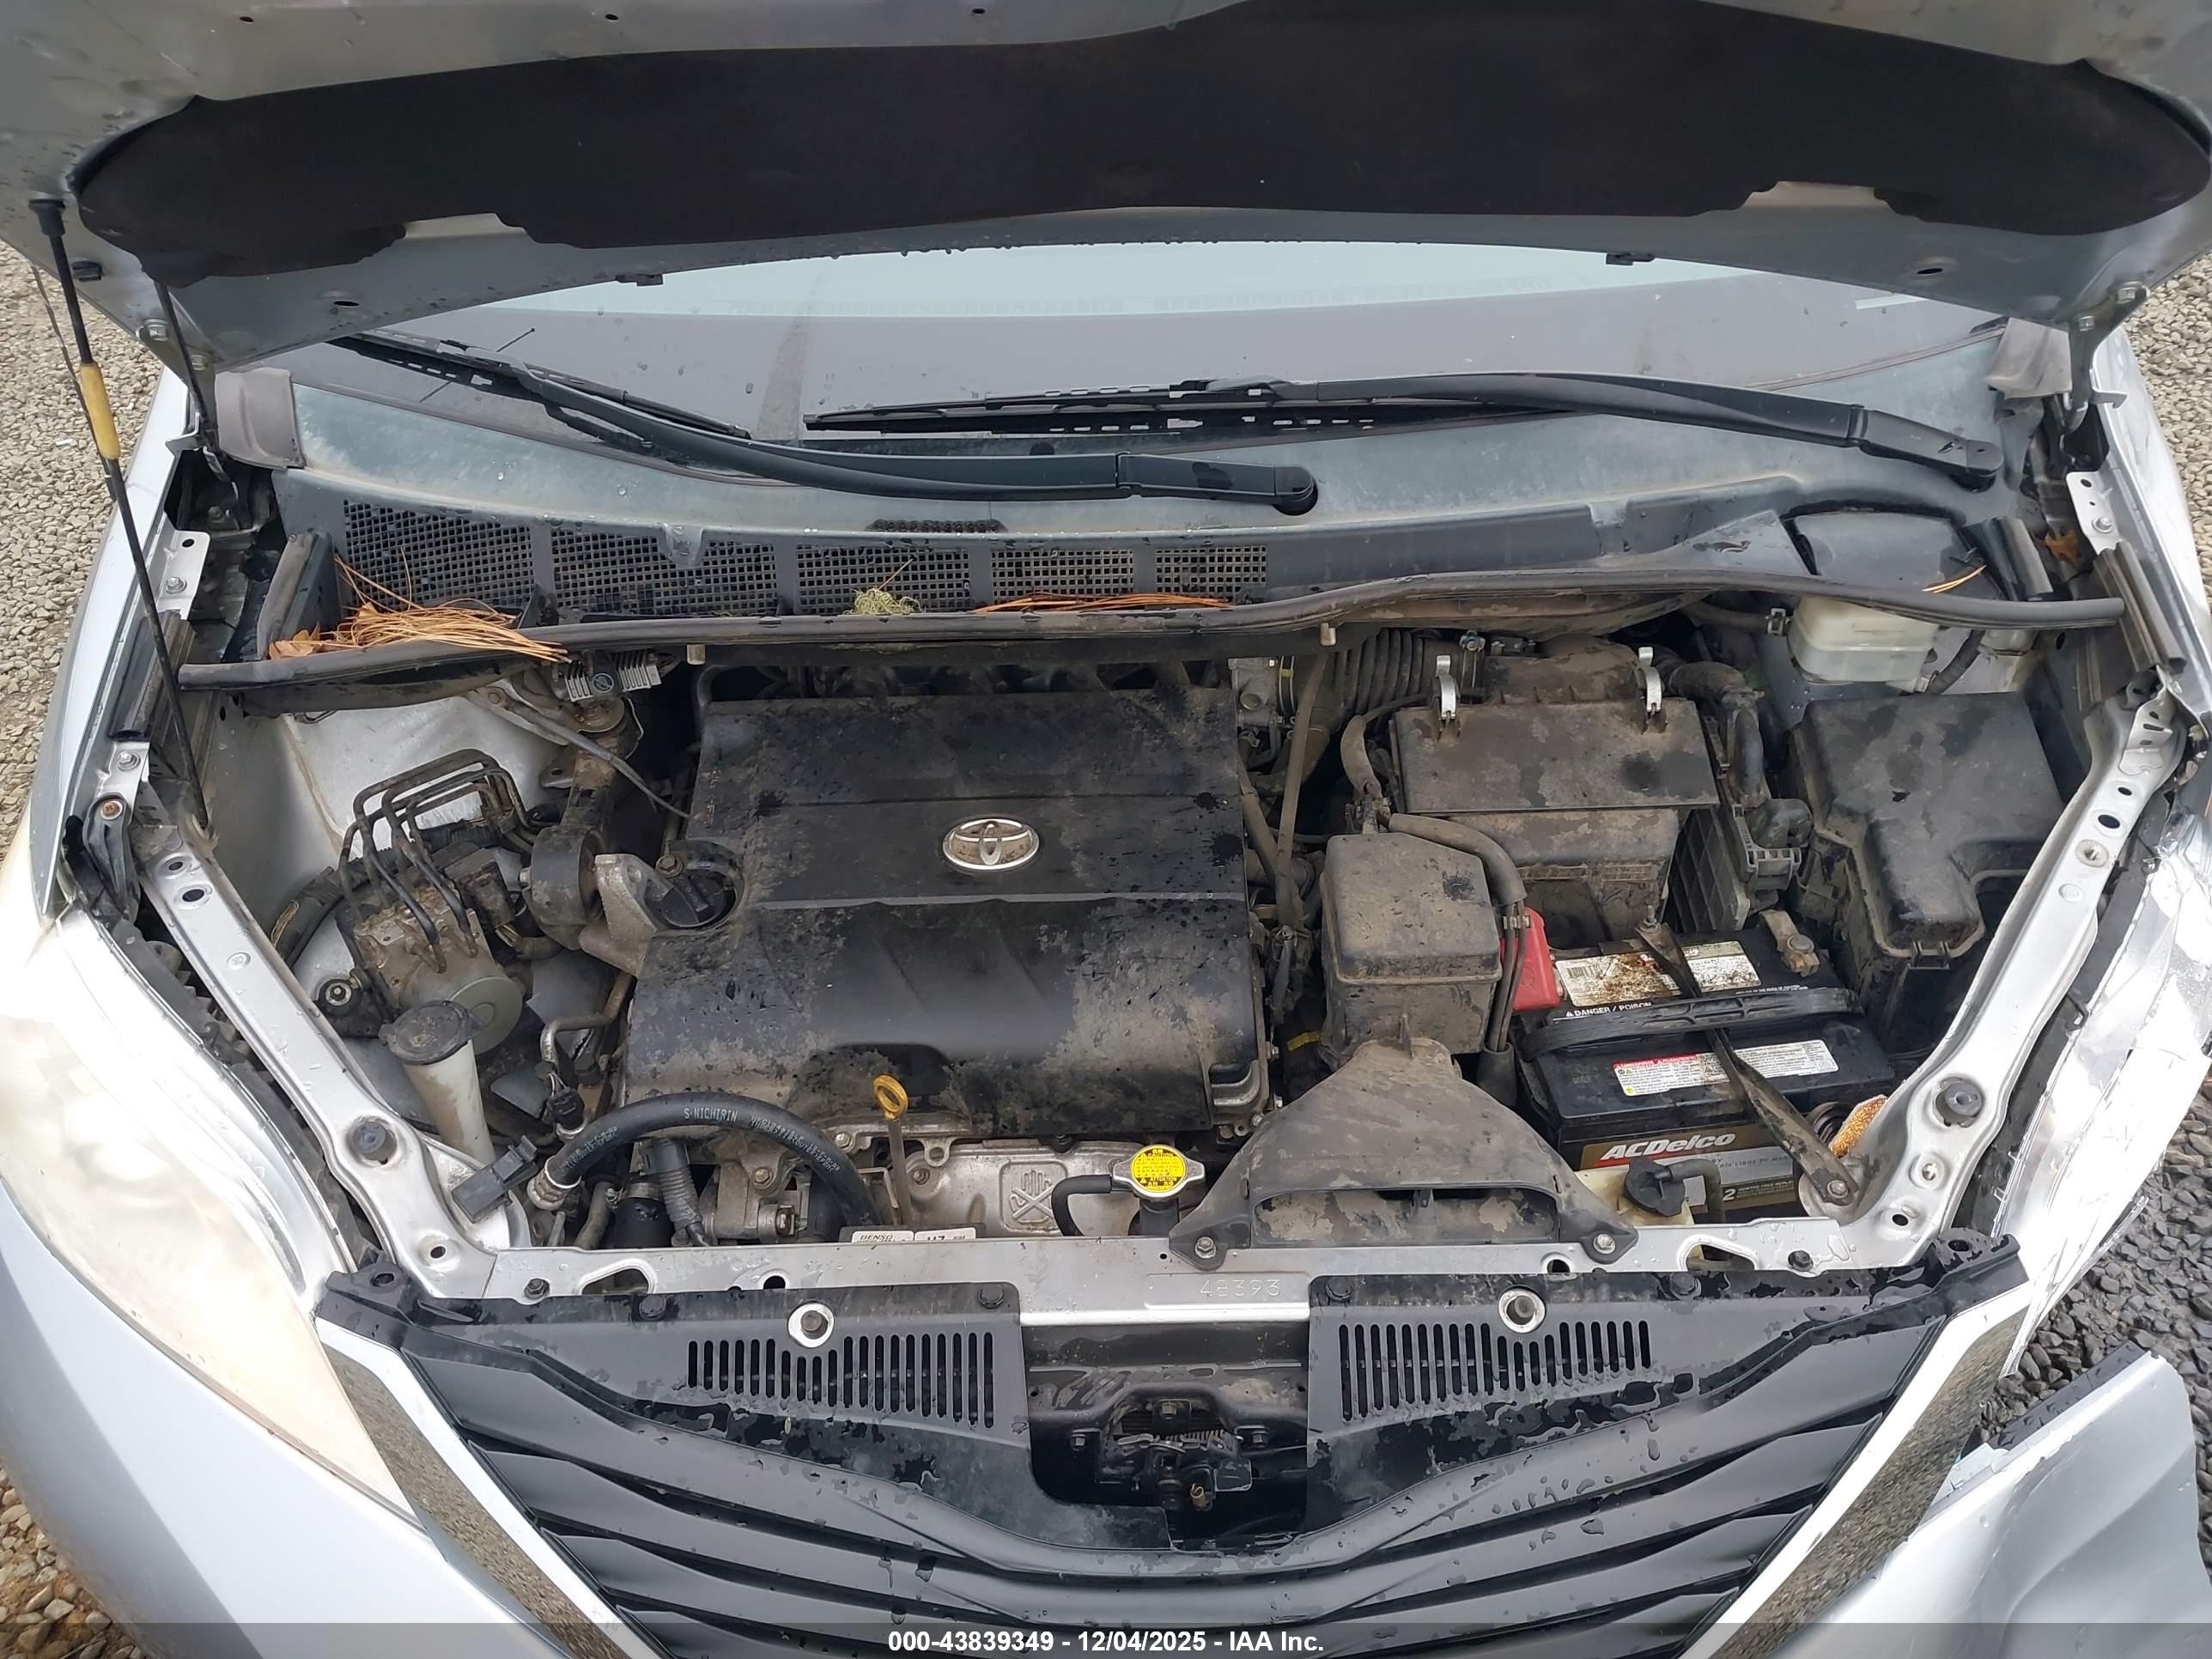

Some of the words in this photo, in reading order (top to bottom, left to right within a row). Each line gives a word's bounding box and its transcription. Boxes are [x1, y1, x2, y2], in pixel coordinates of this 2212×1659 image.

[1574, 1006, 1611, 1017] DANGER
[1619, 1001, 1653, 1012] POISON
[1600, 1133, 1736, 1161] ACDelco
